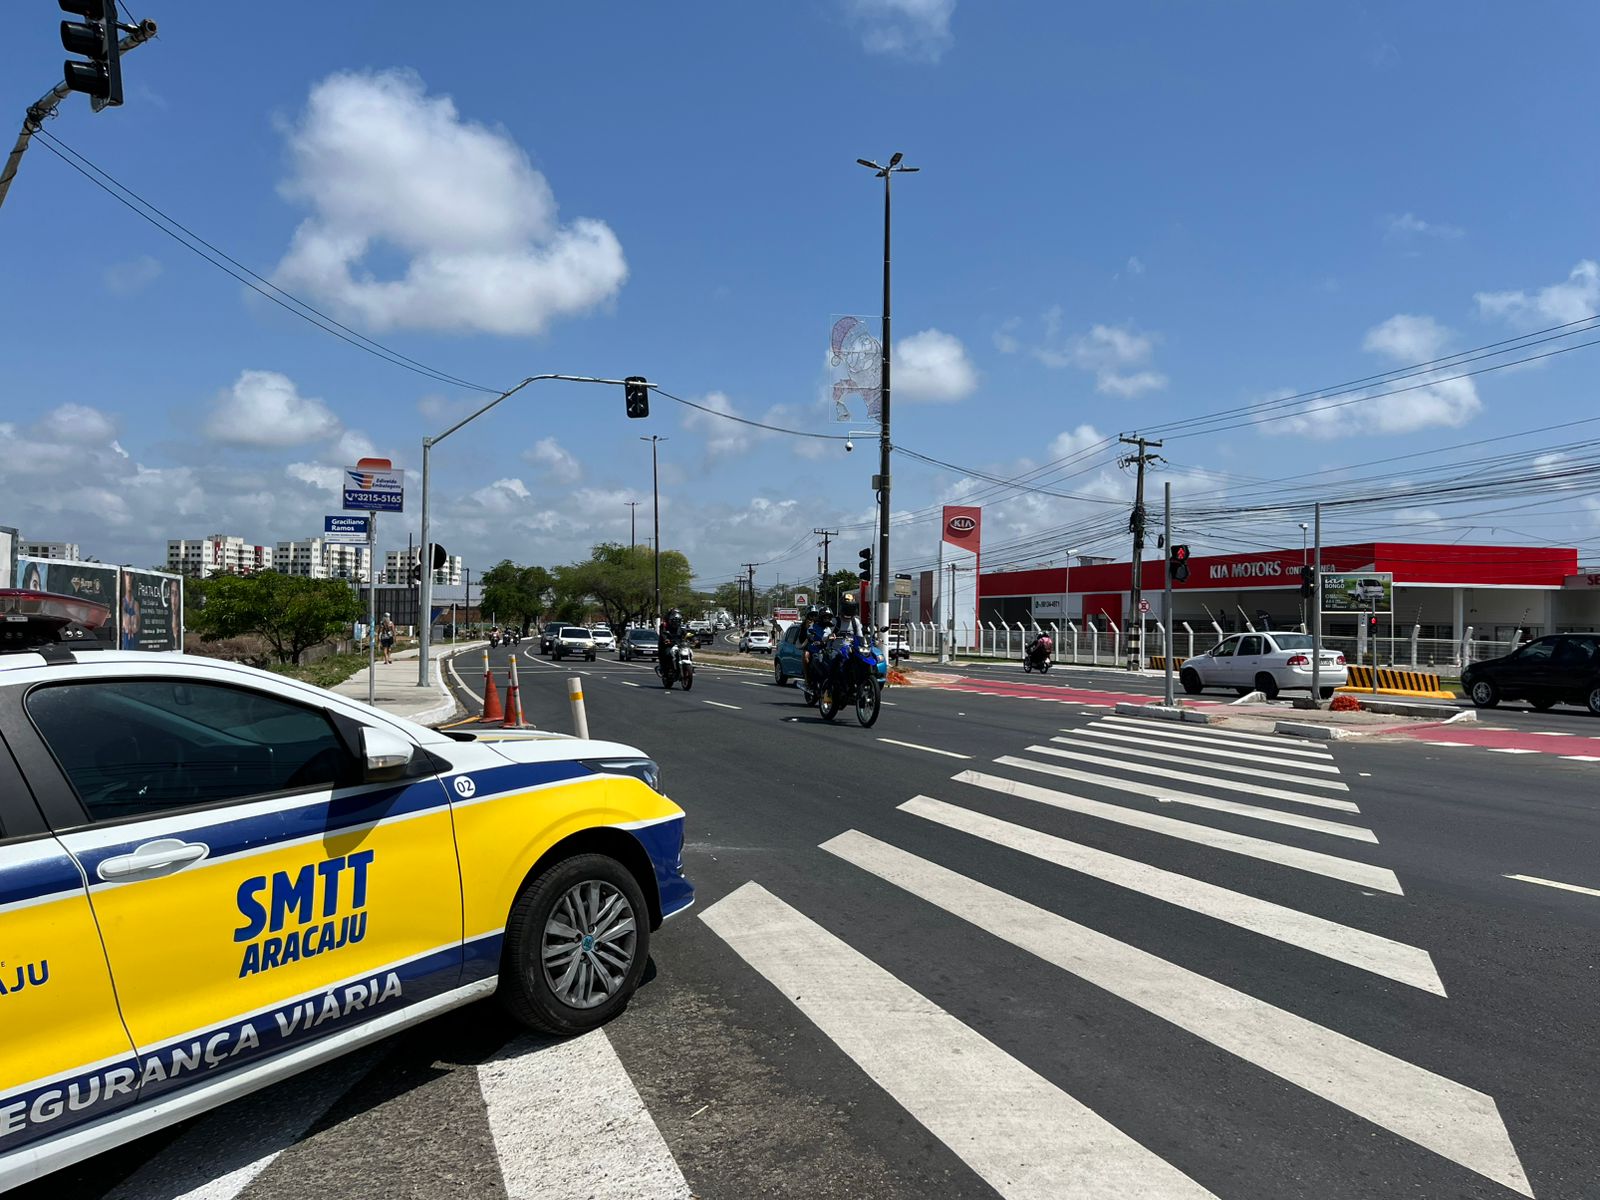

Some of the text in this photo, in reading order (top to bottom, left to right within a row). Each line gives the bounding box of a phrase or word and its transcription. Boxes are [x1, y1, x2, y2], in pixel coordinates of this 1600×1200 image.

[358, 493, 401, 503] 3215-5165
[1209, 564, 1229, 578] KIA
[1231, 561, 1281, 577] MOTORS
[456, 780, 474, 793] 02
[233, 849, 375, 943] SMTT
[238, 911, 368, 979] ARACAJU
[274, 971, 403, 1038] VIÁRIA
